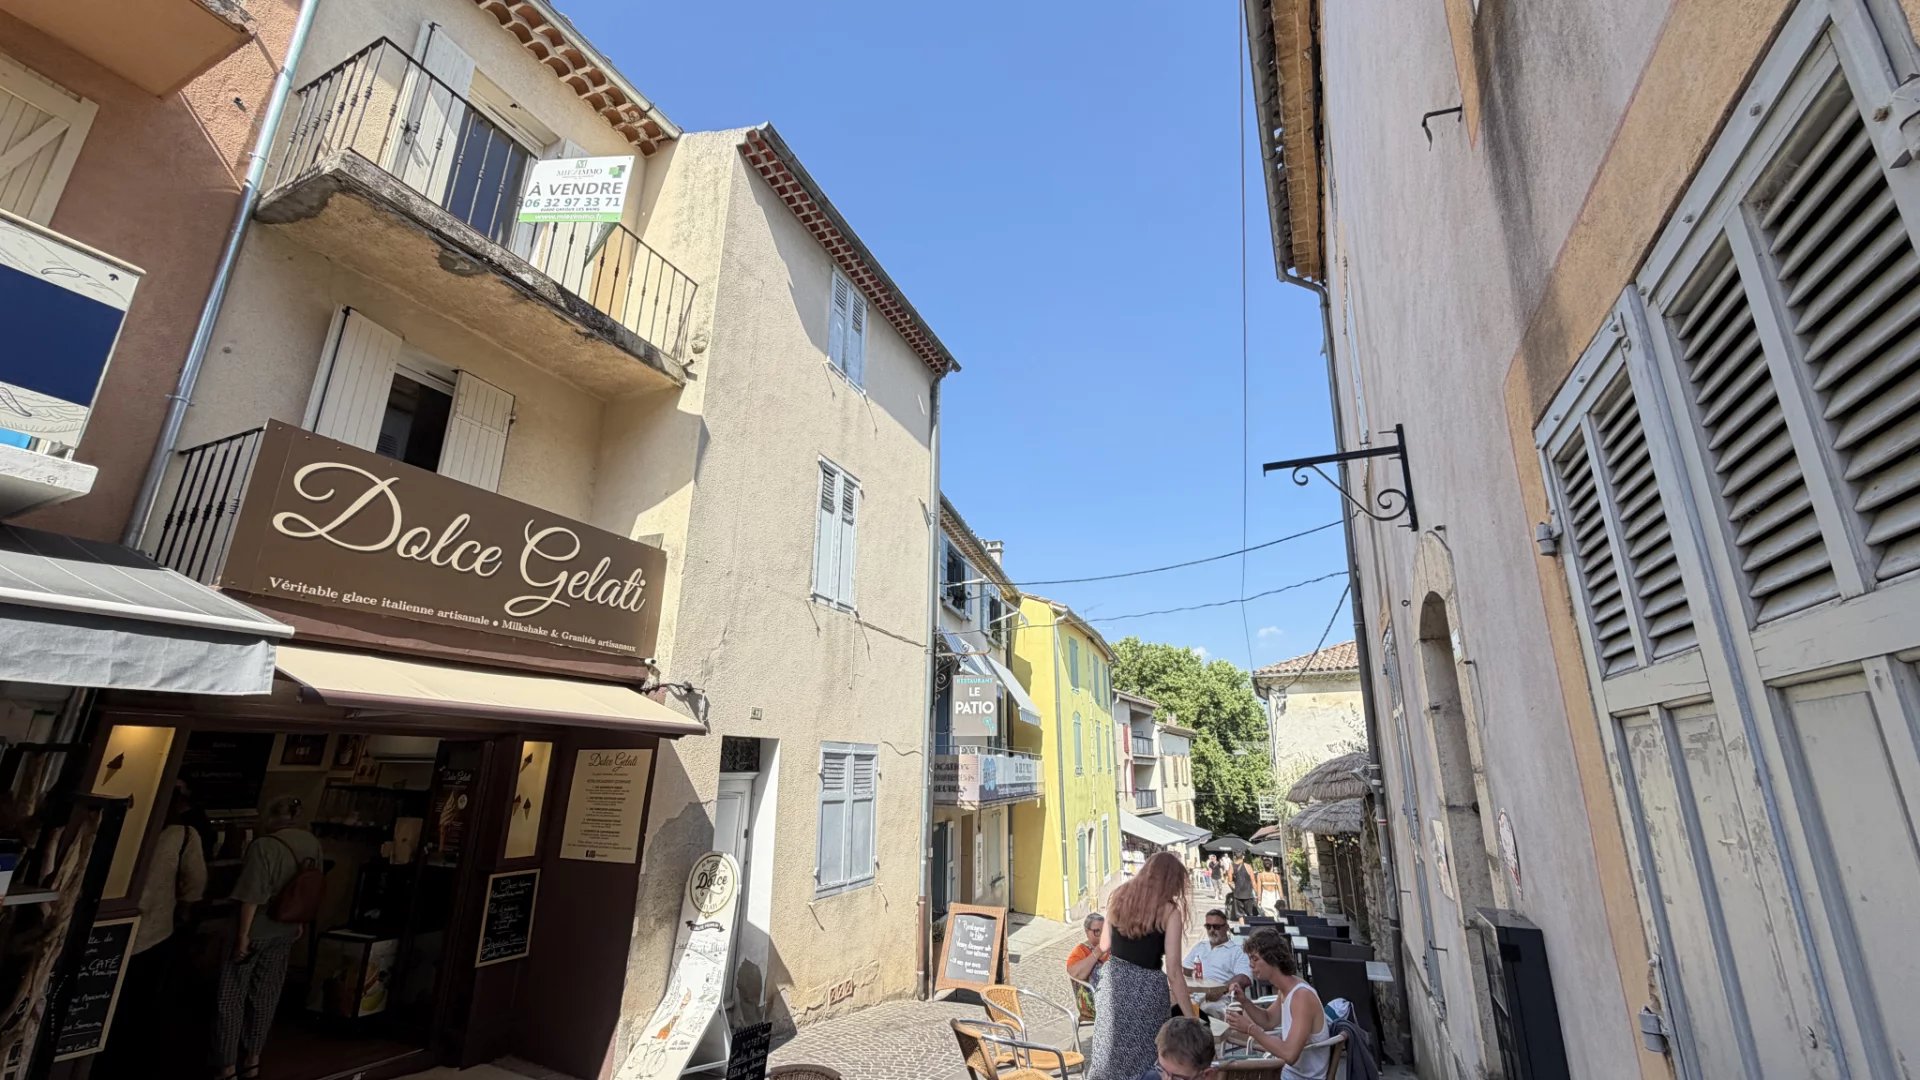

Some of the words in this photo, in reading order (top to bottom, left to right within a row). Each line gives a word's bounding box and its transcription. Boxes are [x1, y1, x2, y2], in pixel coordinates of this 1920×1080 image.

[528, 182, 542, 196] À
[550, 182, 623, 195] VENDRE
[525, 199, 540, 208] 06
[544, 198, 560, 207] 32
[564, 198, 580, 207] 97
[584, 197, 600, 206] 33
[605, 197, 620, 206] 71
[272, 462, 502, 577] Dolce
[504, 520, 646, 617] Gelati
[269, 576, 338, 599] Véritable
[342, 591, 377, 606] glace
[381, 597, 434, 615] italienne
[437, 609, 490, 626] artisanale
[502, 620, 548, 636] Milkshake
[551, 629, 559, 638] &
[561, 631, 596, 645] Granités
[598, 639, 637, 652] artisanaux
[969, 687, 981, 697] LE
[955, 701, 994, 714] PATIO
[695, 871, 728, 889] Dolce
